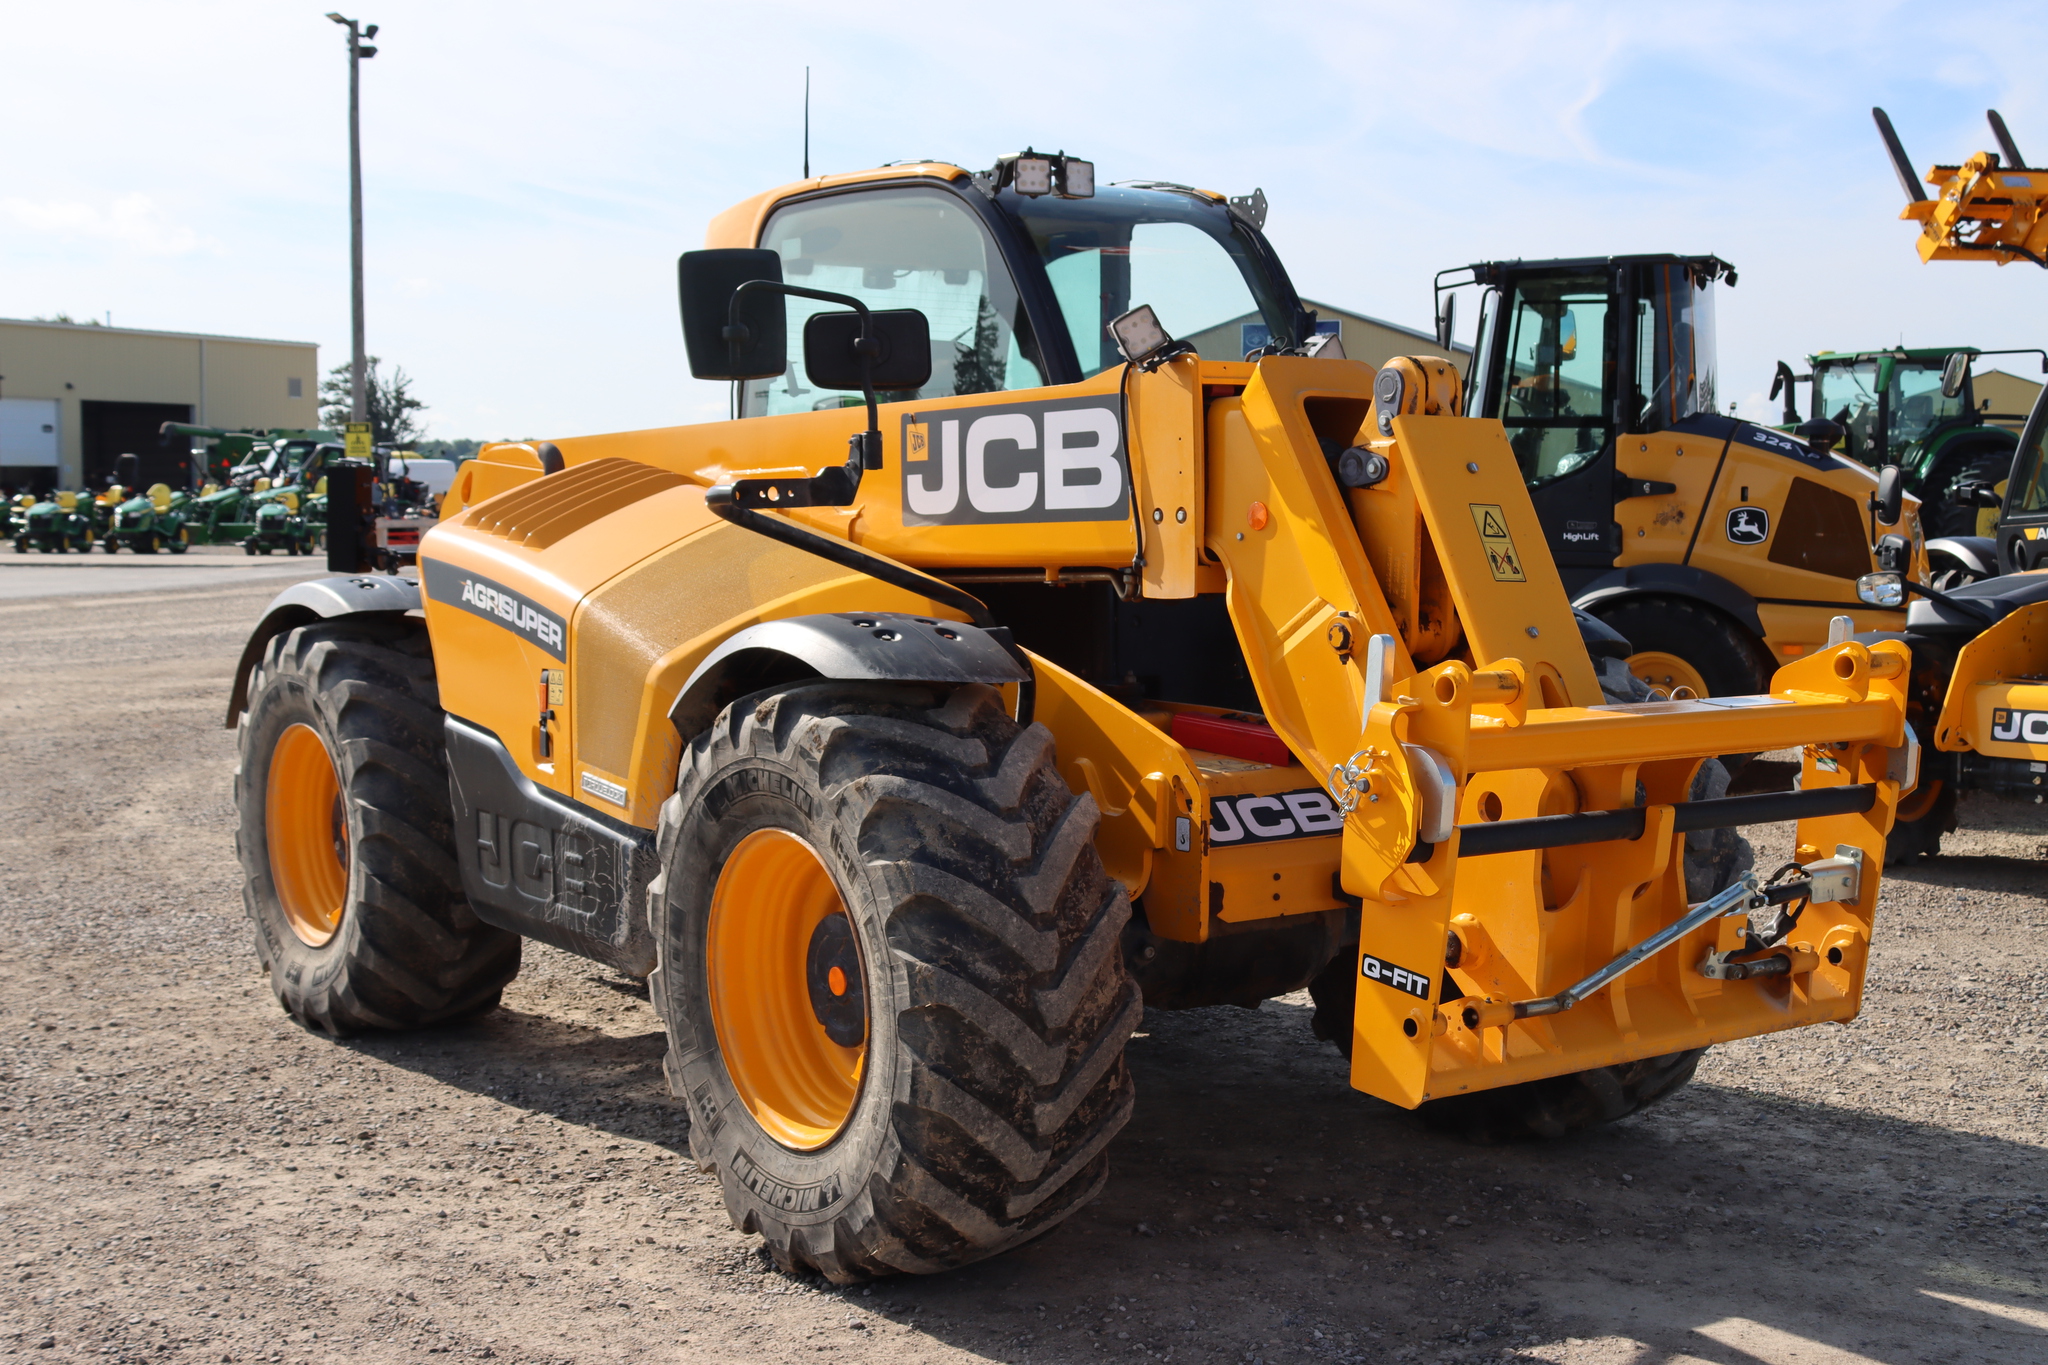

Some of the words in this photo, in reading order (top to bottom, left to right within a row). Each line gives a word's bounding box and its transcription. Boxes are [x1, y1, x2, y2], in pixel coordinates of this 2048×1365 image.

[907, 407, 1122, 515] JCB
[912, 433, 925, 451] JCB
[1753, 432, 1792, 450] 324
[461, 579, 562, 651] AGRISUPER
[725, 769, 812, 819] MICHELIN
[1210, 792, 1344, 842] JCB
[477, 809, 599, 915] JCB
[1363, 957, 1428, 995] Q-FIT
[732, 1154, 821, 1212] MICHELIN
